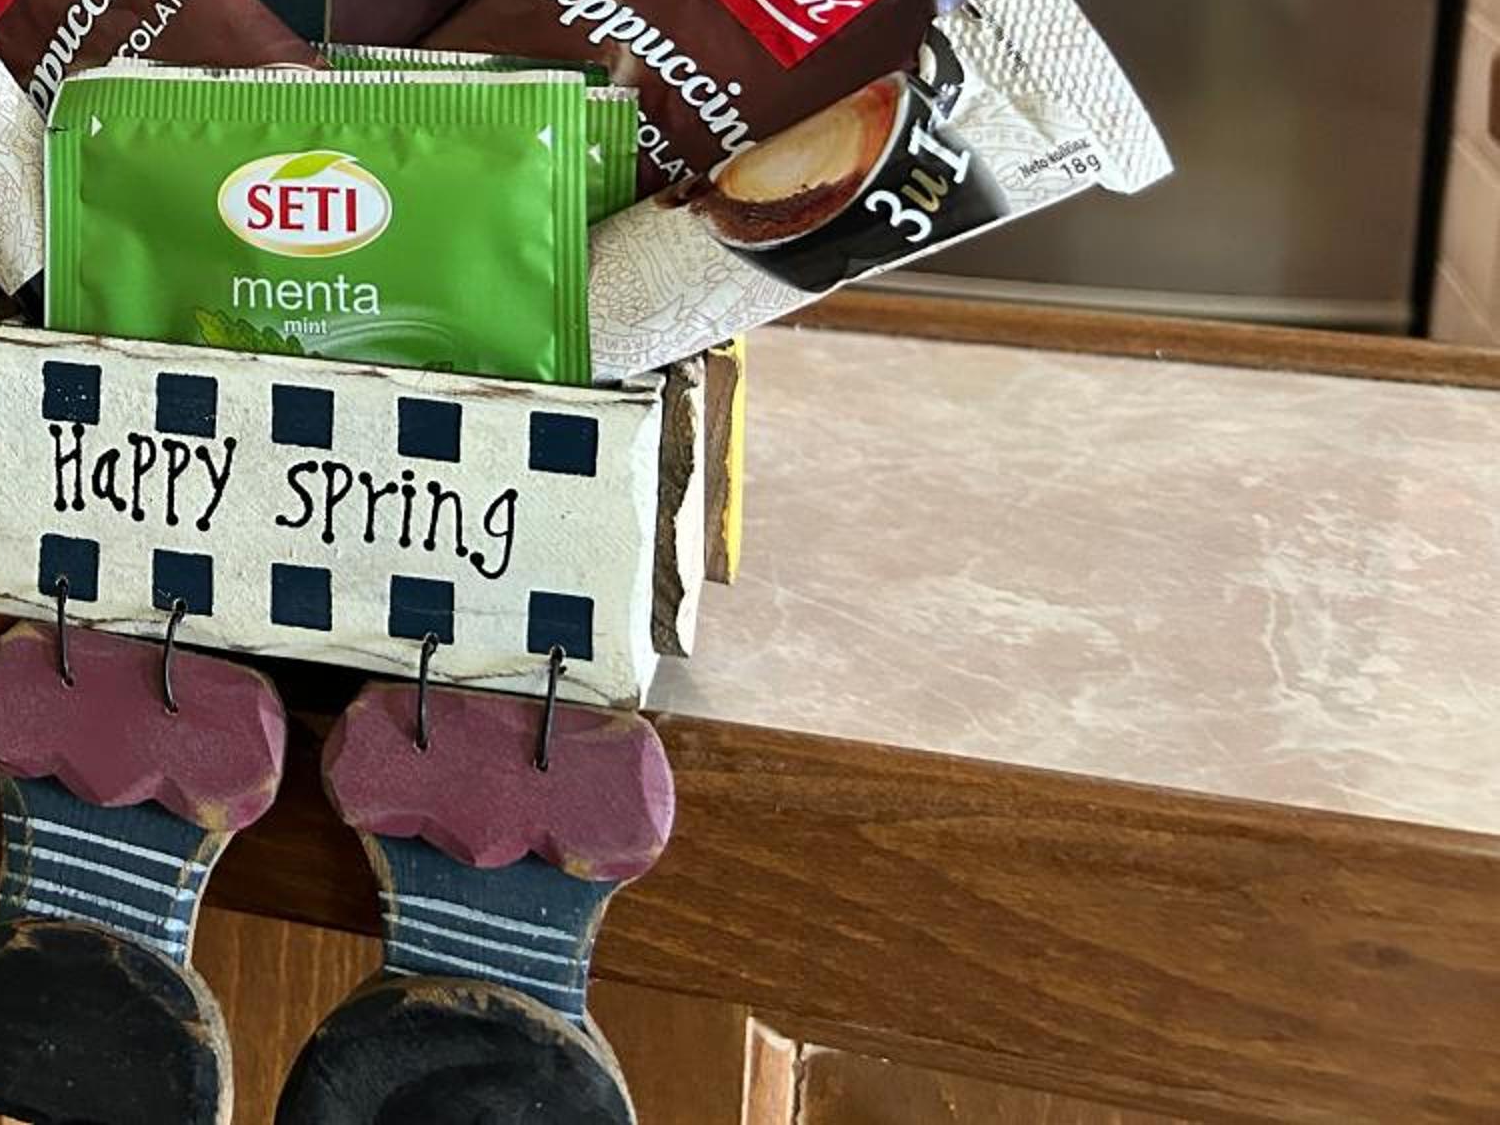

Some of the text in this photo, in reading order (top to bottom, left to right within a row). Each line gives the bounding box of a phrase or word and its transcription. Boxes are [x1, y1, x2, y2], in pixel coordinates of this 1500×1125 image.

[247, 184, 357, 232] SETI
[233, 274, 380, 315] menta
[283, 317, 327, 335] mint
[49, 423, 237, 532] Happy
